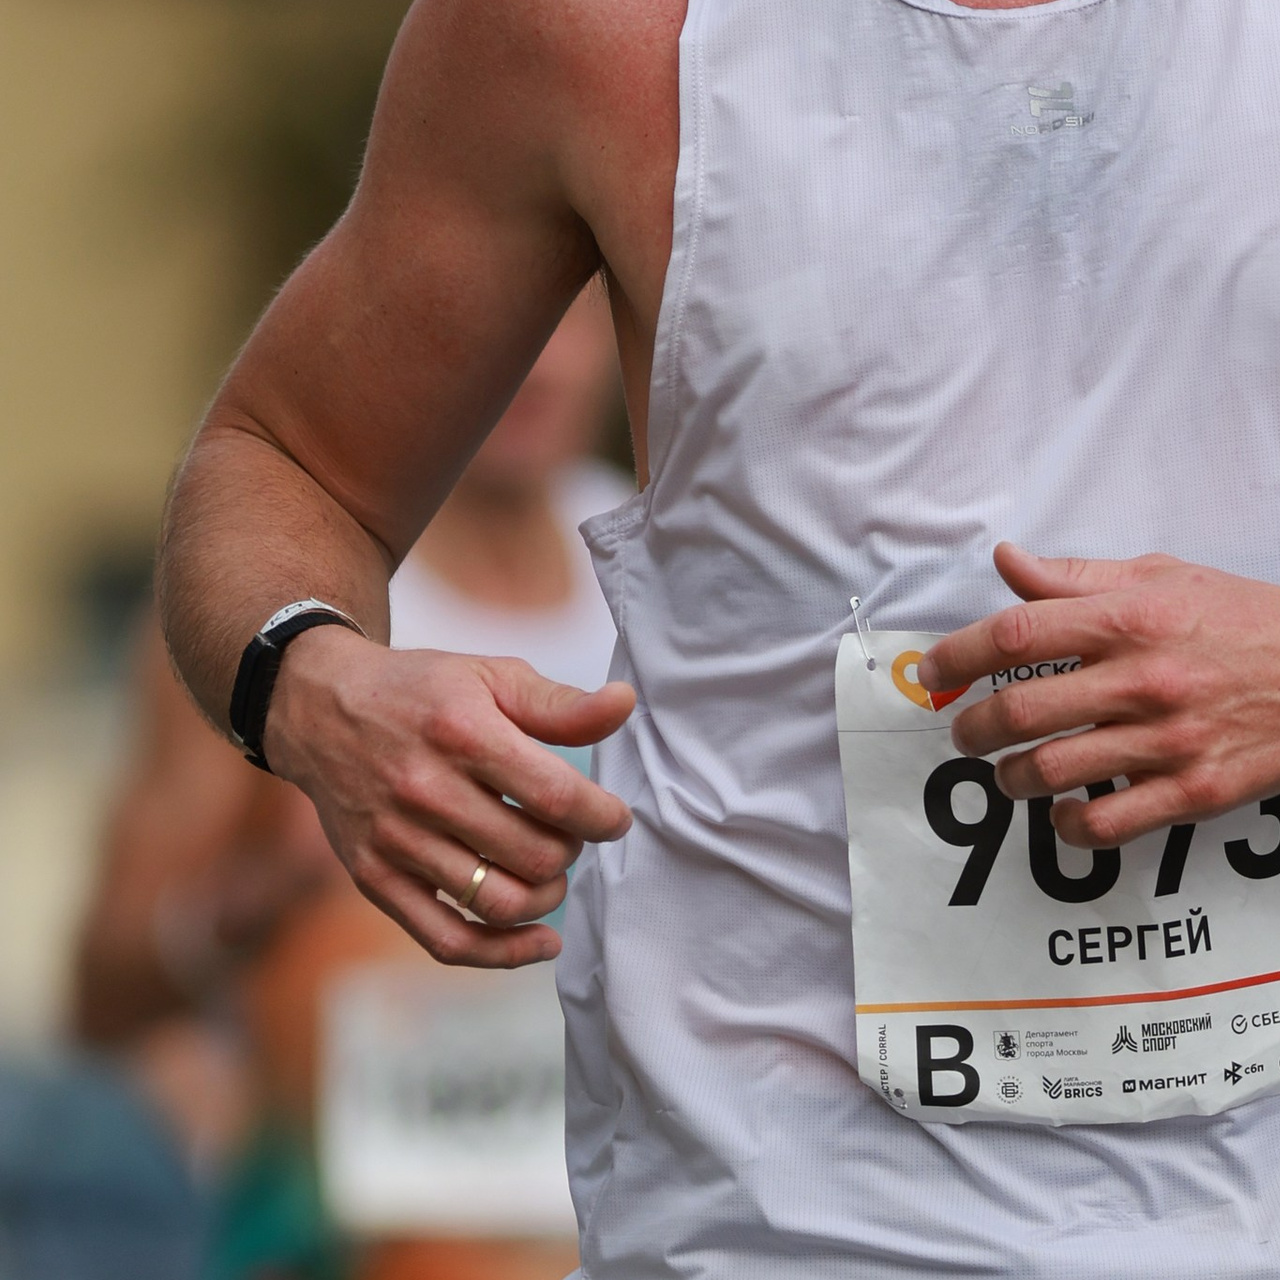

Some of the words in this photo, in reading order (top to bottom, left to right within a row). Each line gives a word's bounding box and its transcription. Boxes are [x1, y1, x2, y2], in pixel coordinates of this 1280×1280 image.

[1048, 907, 1212, 966] СЕРГЕЙ
[1141, 1013, 1212, 1038] МОСКОВСКИЙ
[878, 1024, 887, 1061] CORRAL
[1025, 1030, 1079, 1039] Департамент
[1142, 1036, 1177, 1053] СПОРТ
[1026, 1050, 1054, 1058] города
[1056, 1049, 1087, 1057] Москвы
[1064, 1087, 1103, 1099] BRICS
